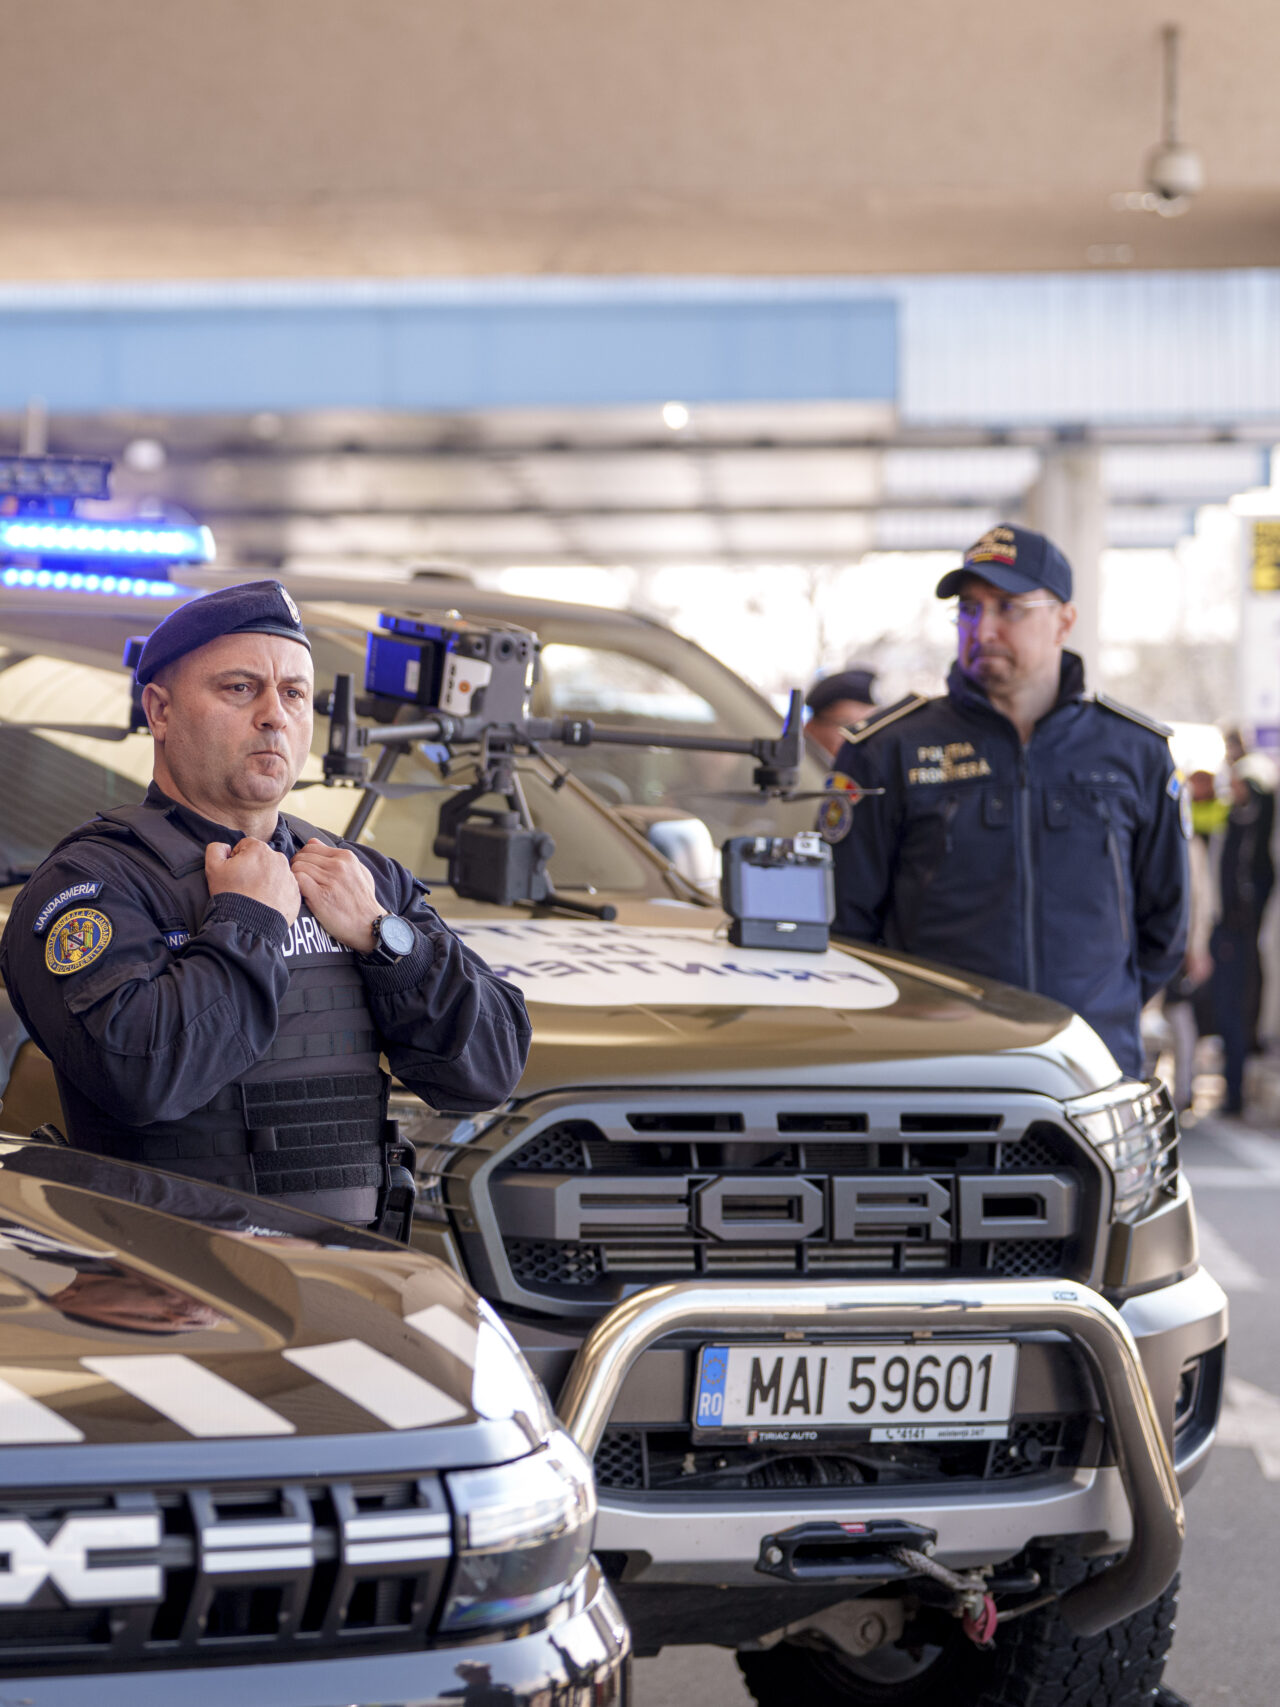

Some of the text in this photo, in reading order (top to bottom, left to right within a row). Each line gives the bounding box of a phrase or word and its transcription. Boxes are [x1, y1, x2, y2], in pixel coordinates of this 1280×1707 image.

[555, 1174, 1077, 1242] FORD
[698, 1392, 723, 1417] RO
[746, 1354, 993, 1417] MAI 59601
